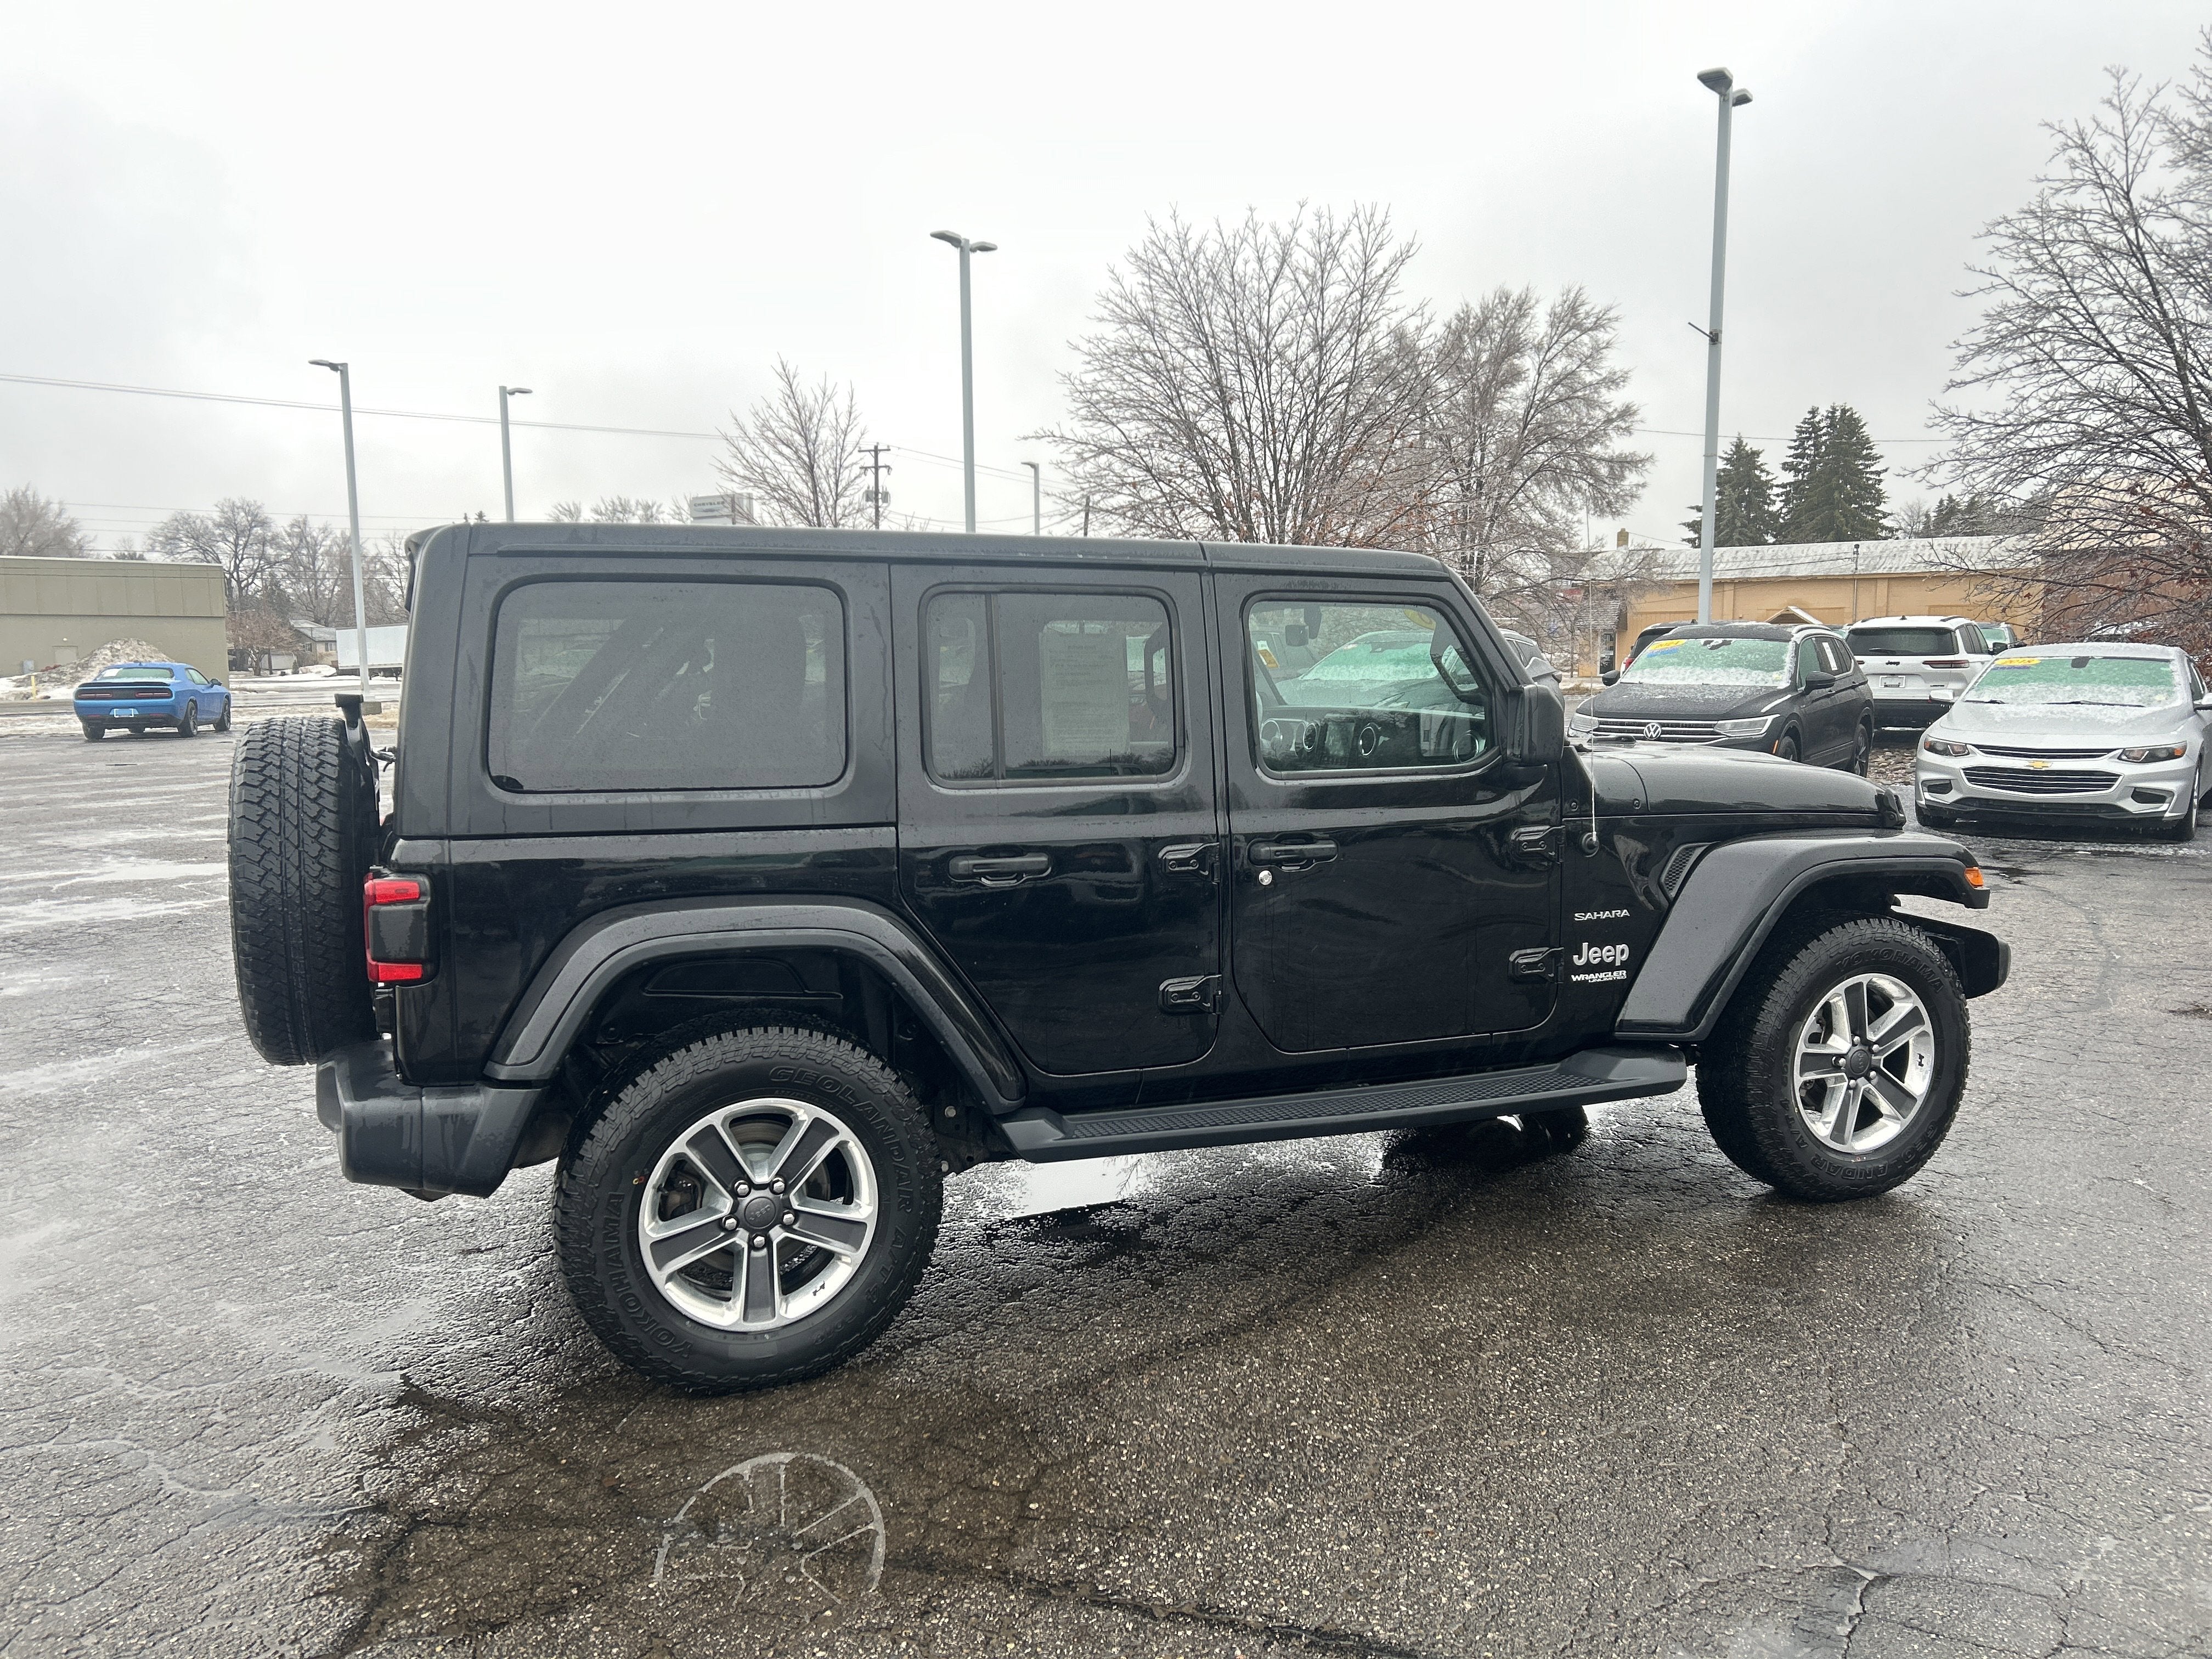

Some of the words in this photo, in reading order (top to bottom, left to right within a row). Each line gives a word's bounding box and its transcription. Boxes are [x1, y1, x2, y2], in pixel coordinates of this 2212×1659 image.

[1574, 909, 1630, 921] SAHARA
[1573, 942, 1629, 966] Jeep
[1836, 947, 1945, 993] YOKOHAMA
[1571, 970, 1627, 981] WRANGLER
[769, 1066, 913, 1212] GEOLANDAR
[602, 1192, 693, 1358] YOKOHAMA
